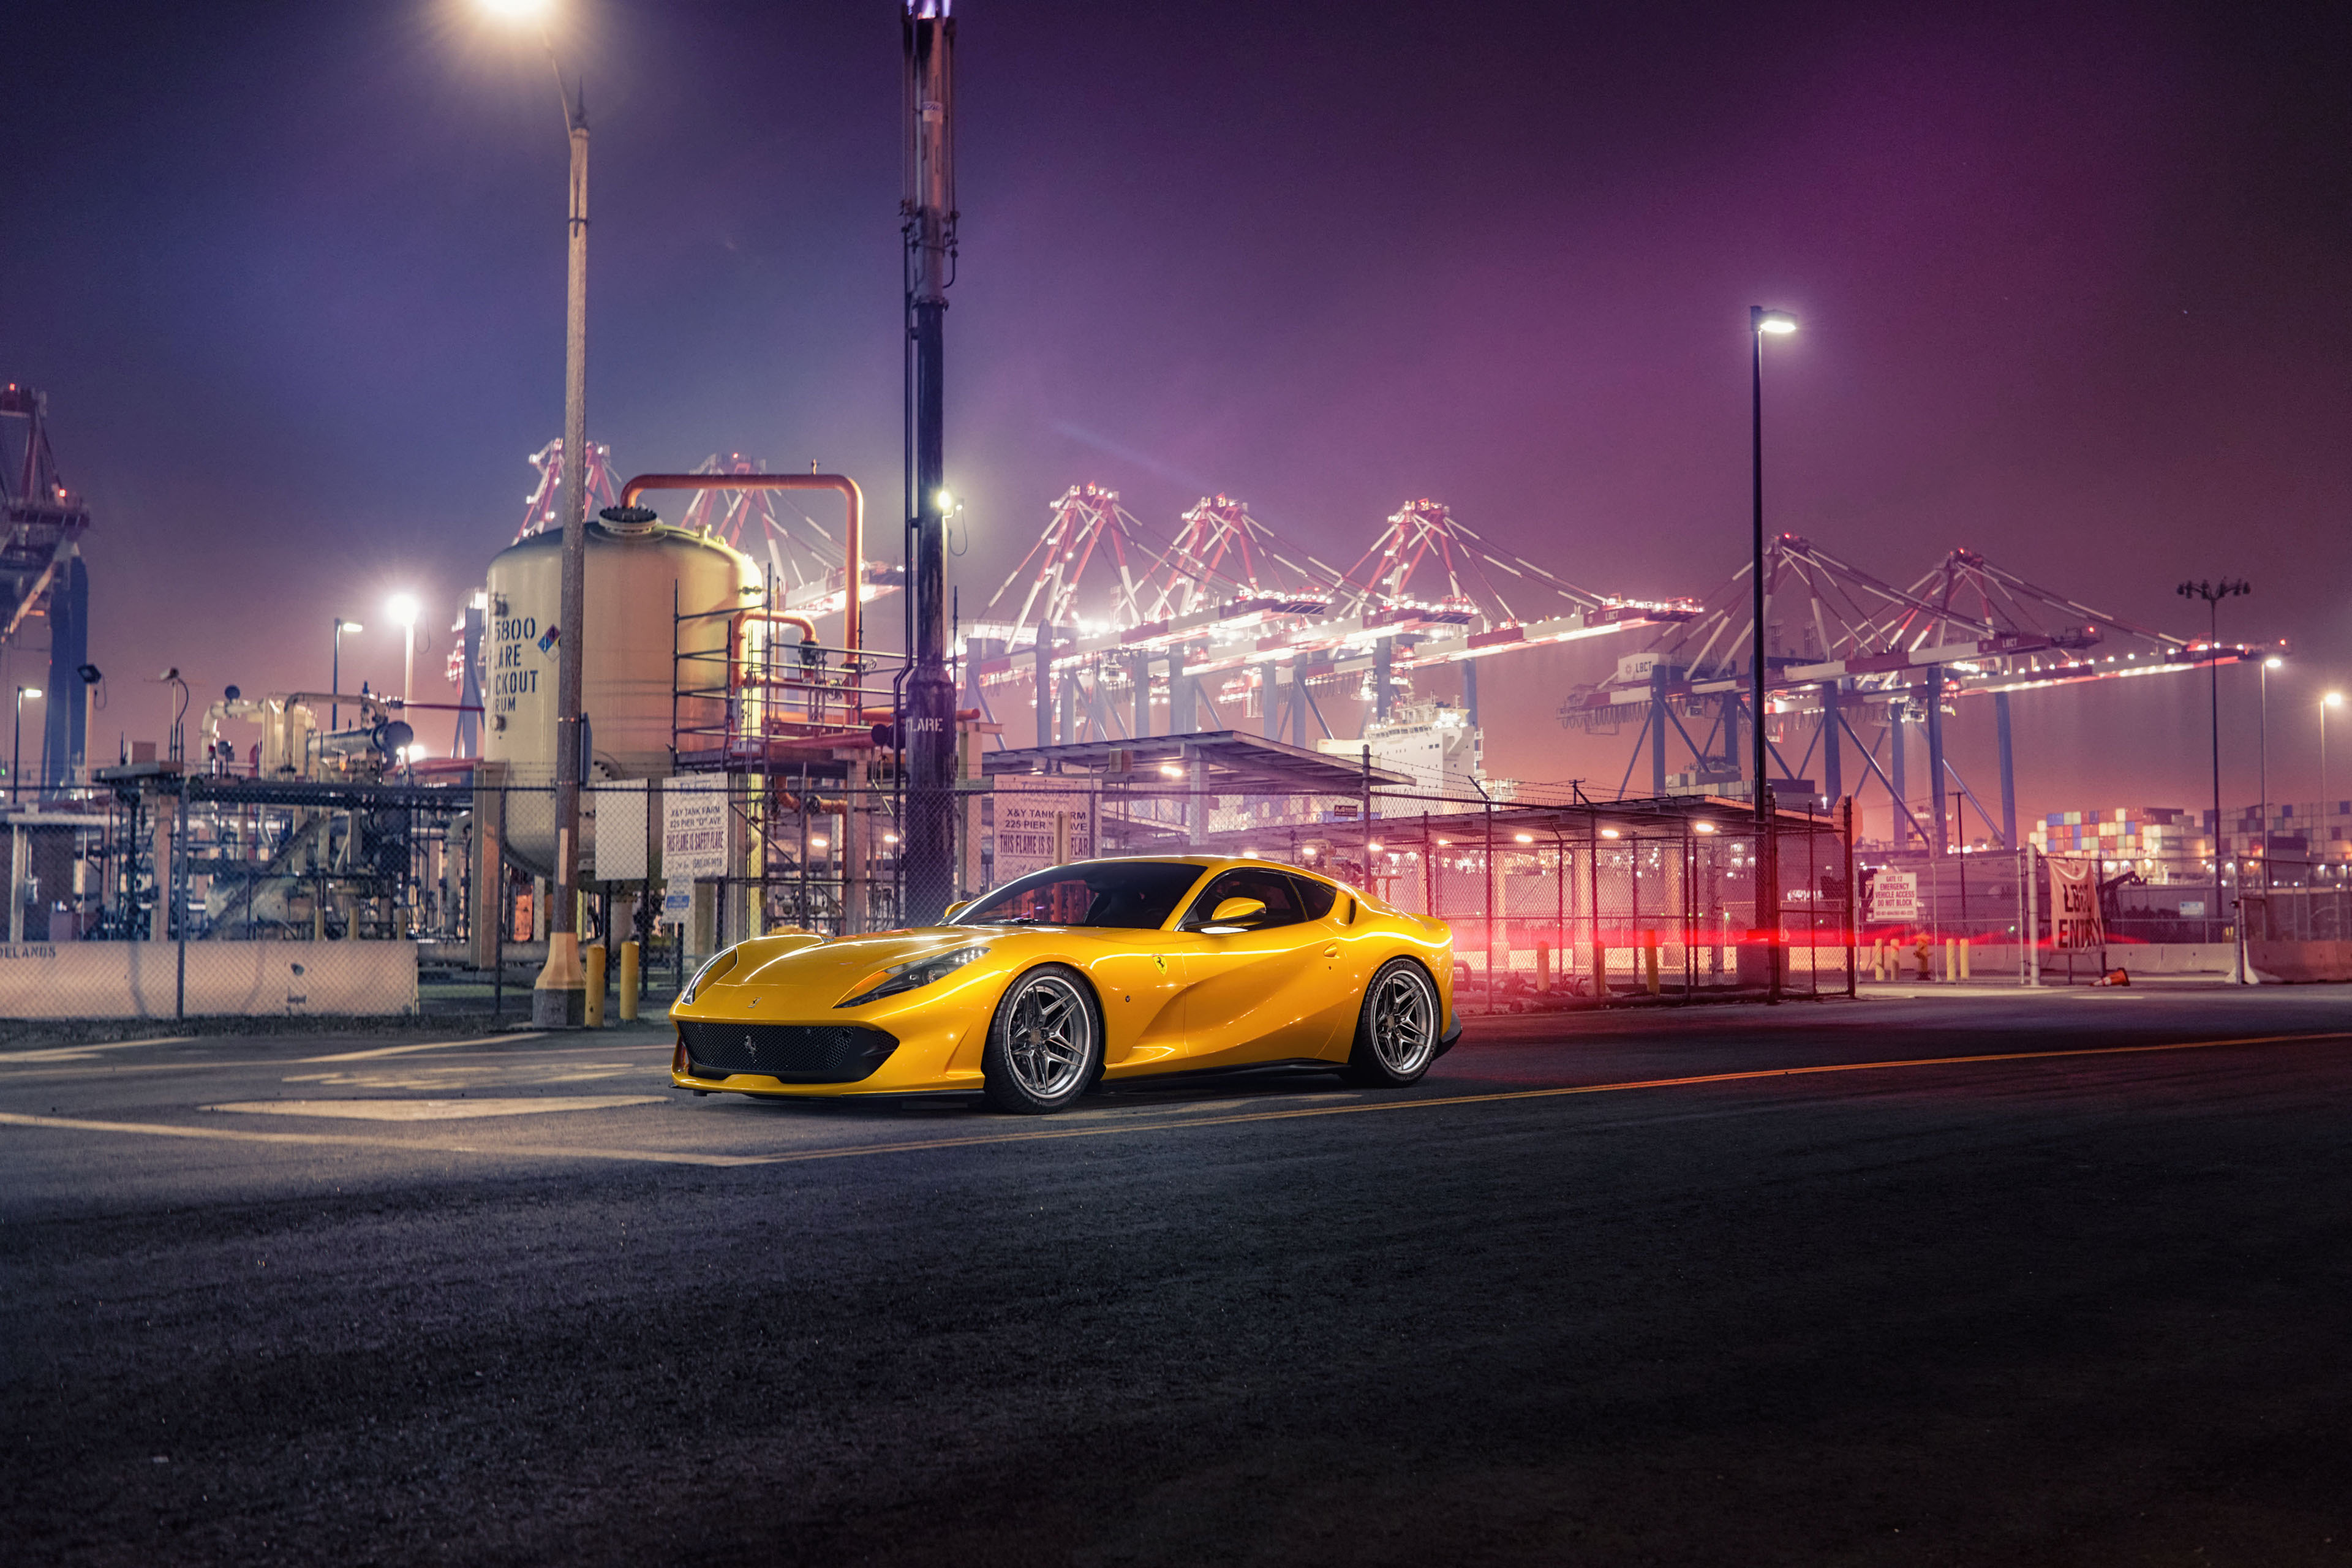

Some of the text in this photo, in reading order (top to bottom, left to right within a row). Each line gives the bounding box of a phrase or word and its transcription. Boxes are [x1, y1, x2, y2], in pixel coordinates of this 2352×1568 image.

[495, 644, 521, 669] ARE
[1635, 662, 1652, 673] LBCT
[496, 670, 538, 696] CKOUT
[492, 696, 516, 714] RUM
[685, 806, 700, 816] TANK
[1007, 809, 1026, 818] X&Y
[1030, 810, 1054, 818] TANK
[681, 818, 695, 827] PIER
[709, 816, 721, 825] AVE
[1024, 821, 1046, 829] PIER
[1000, 835, 1014, 853] THIS
[1016, 835, 1036, 854] FLAME
[1039, 835, 1044, 854] IS
[1071, 837, 1088, 856] FLAR
[2059, 918, 2104, 948] ENTRY
